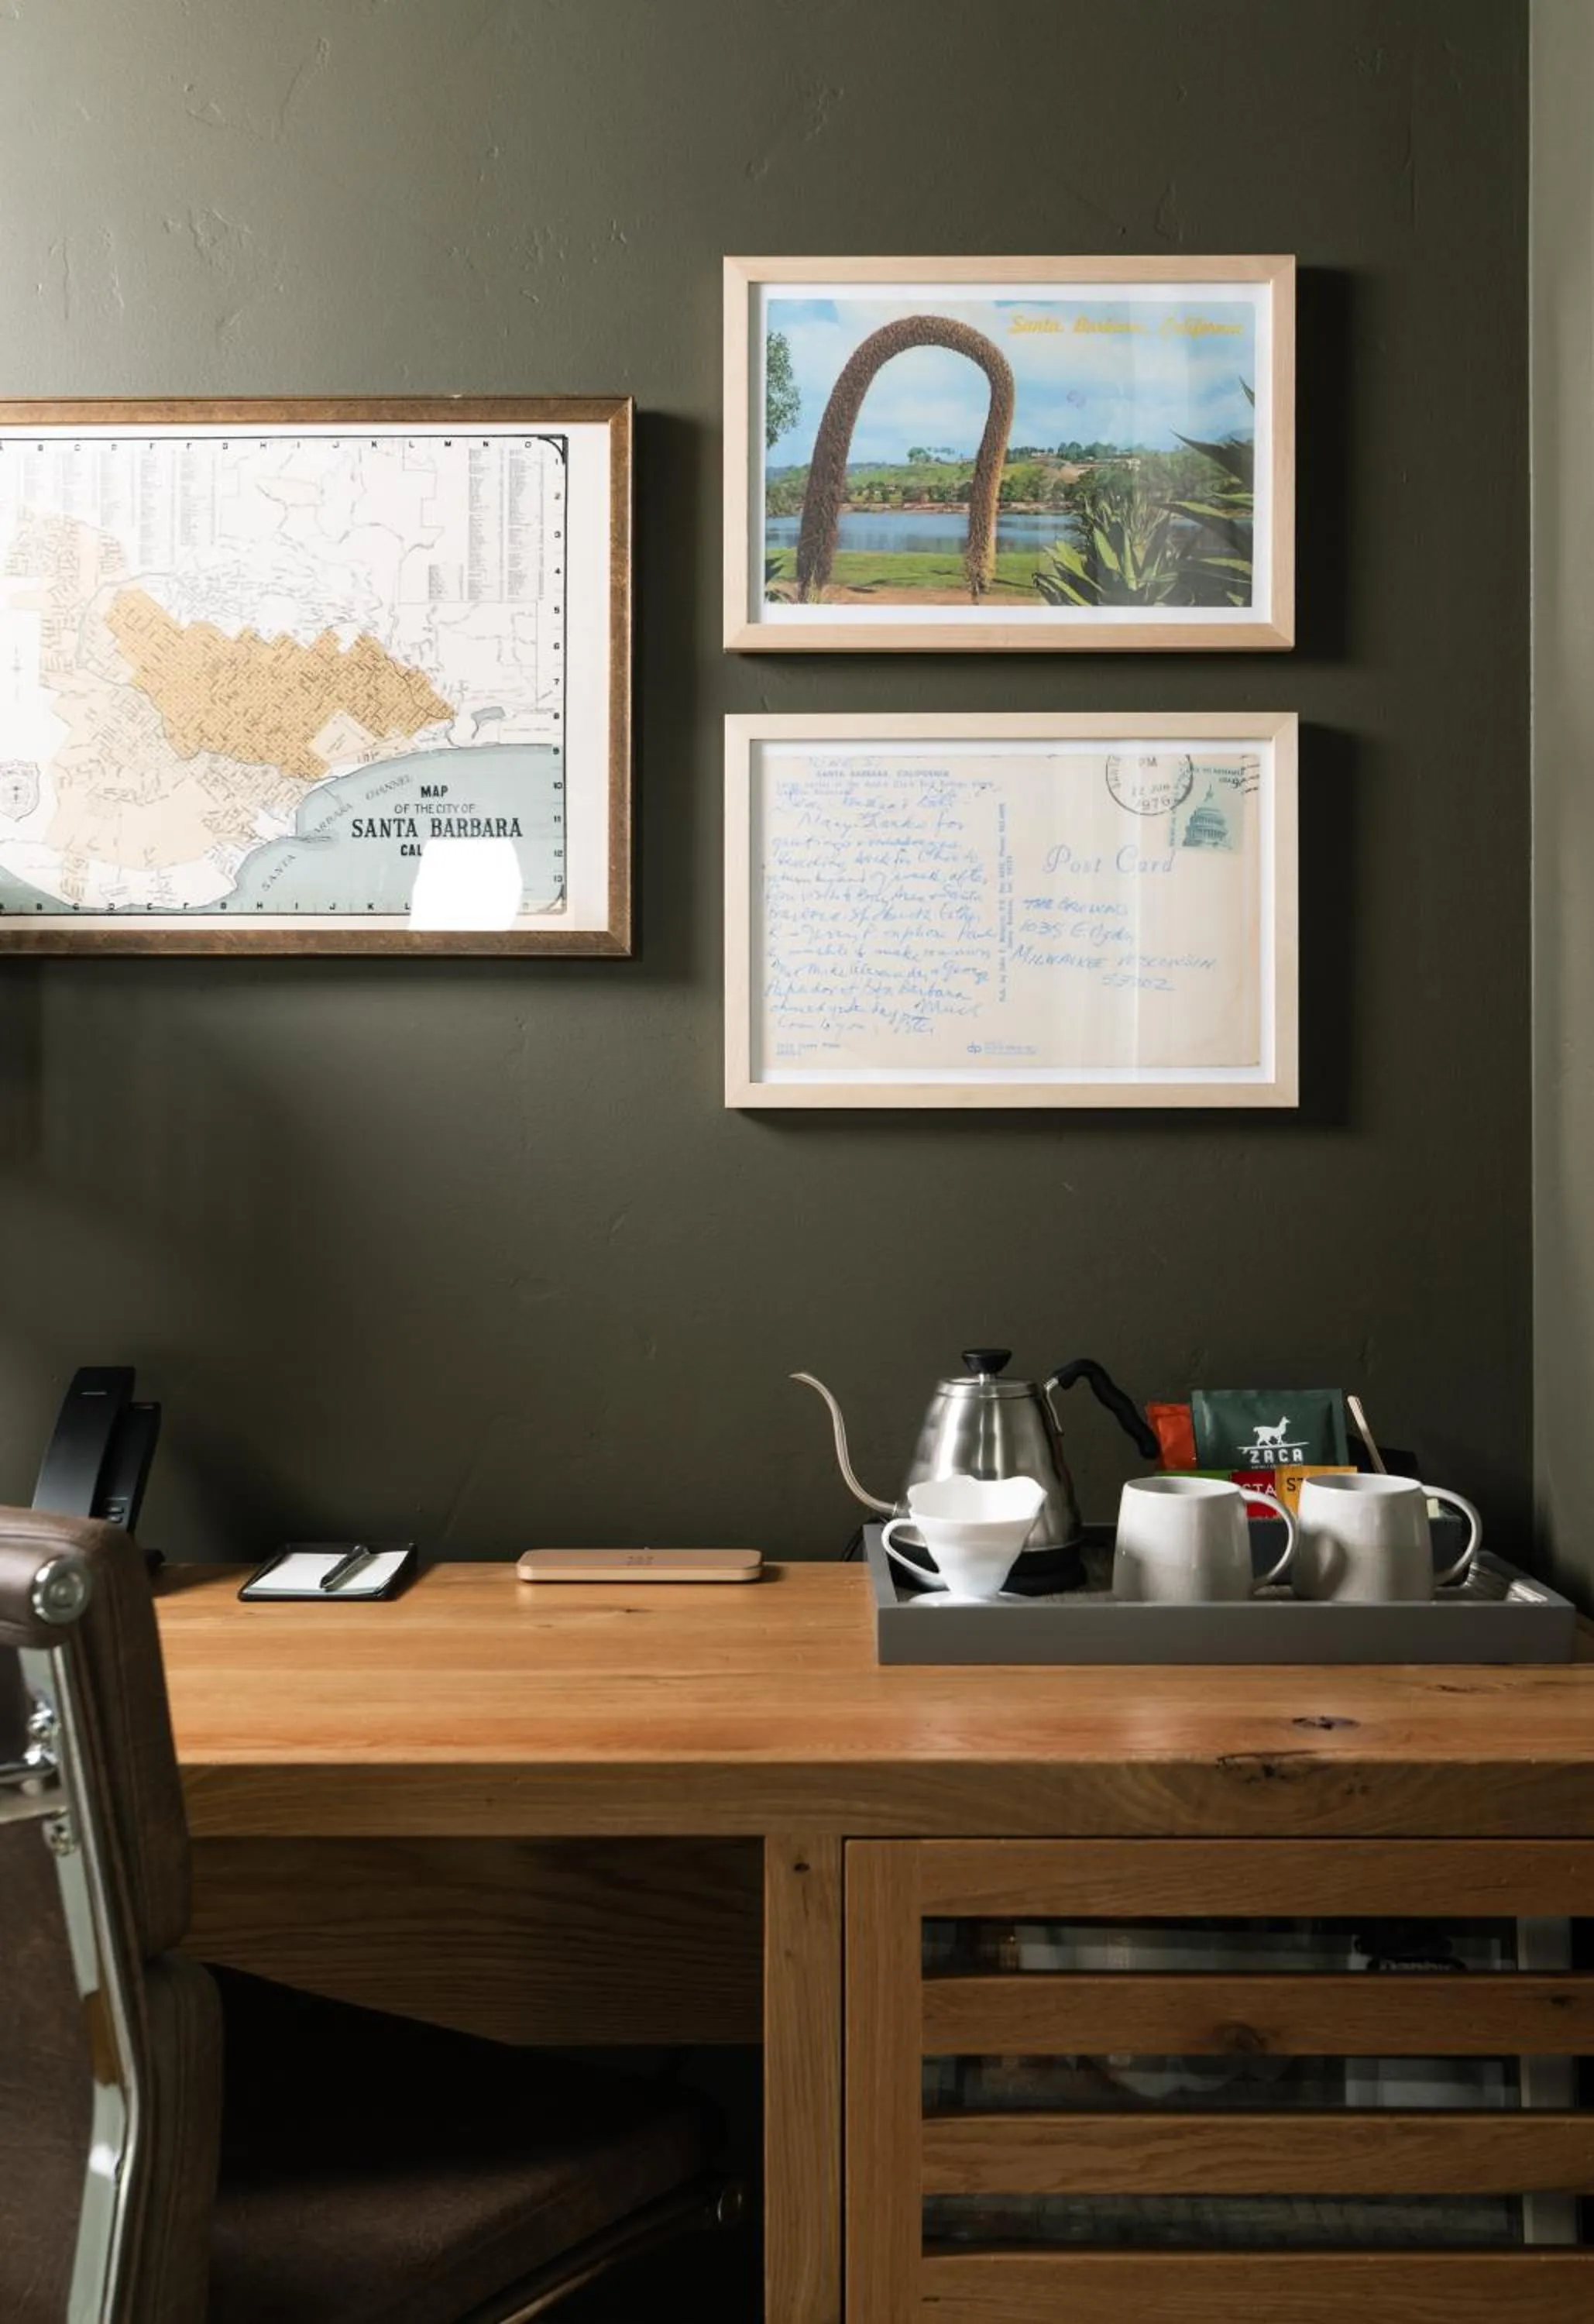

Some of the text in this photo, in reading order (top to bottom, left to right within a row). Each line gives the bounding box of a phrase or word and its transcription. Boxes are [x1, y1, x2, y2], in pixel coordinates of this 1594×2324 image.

[421, 785, 448, 798] MAP
[394, 803, 476, 814] OF THE CITY OF
[351, 817, 524, 838] SANTA BARBARA
[1043, 844, 1101, 875] Post
[1116, 844, 1176, 874] Card
[1249, 1448, 1304, 1463] ZACA
